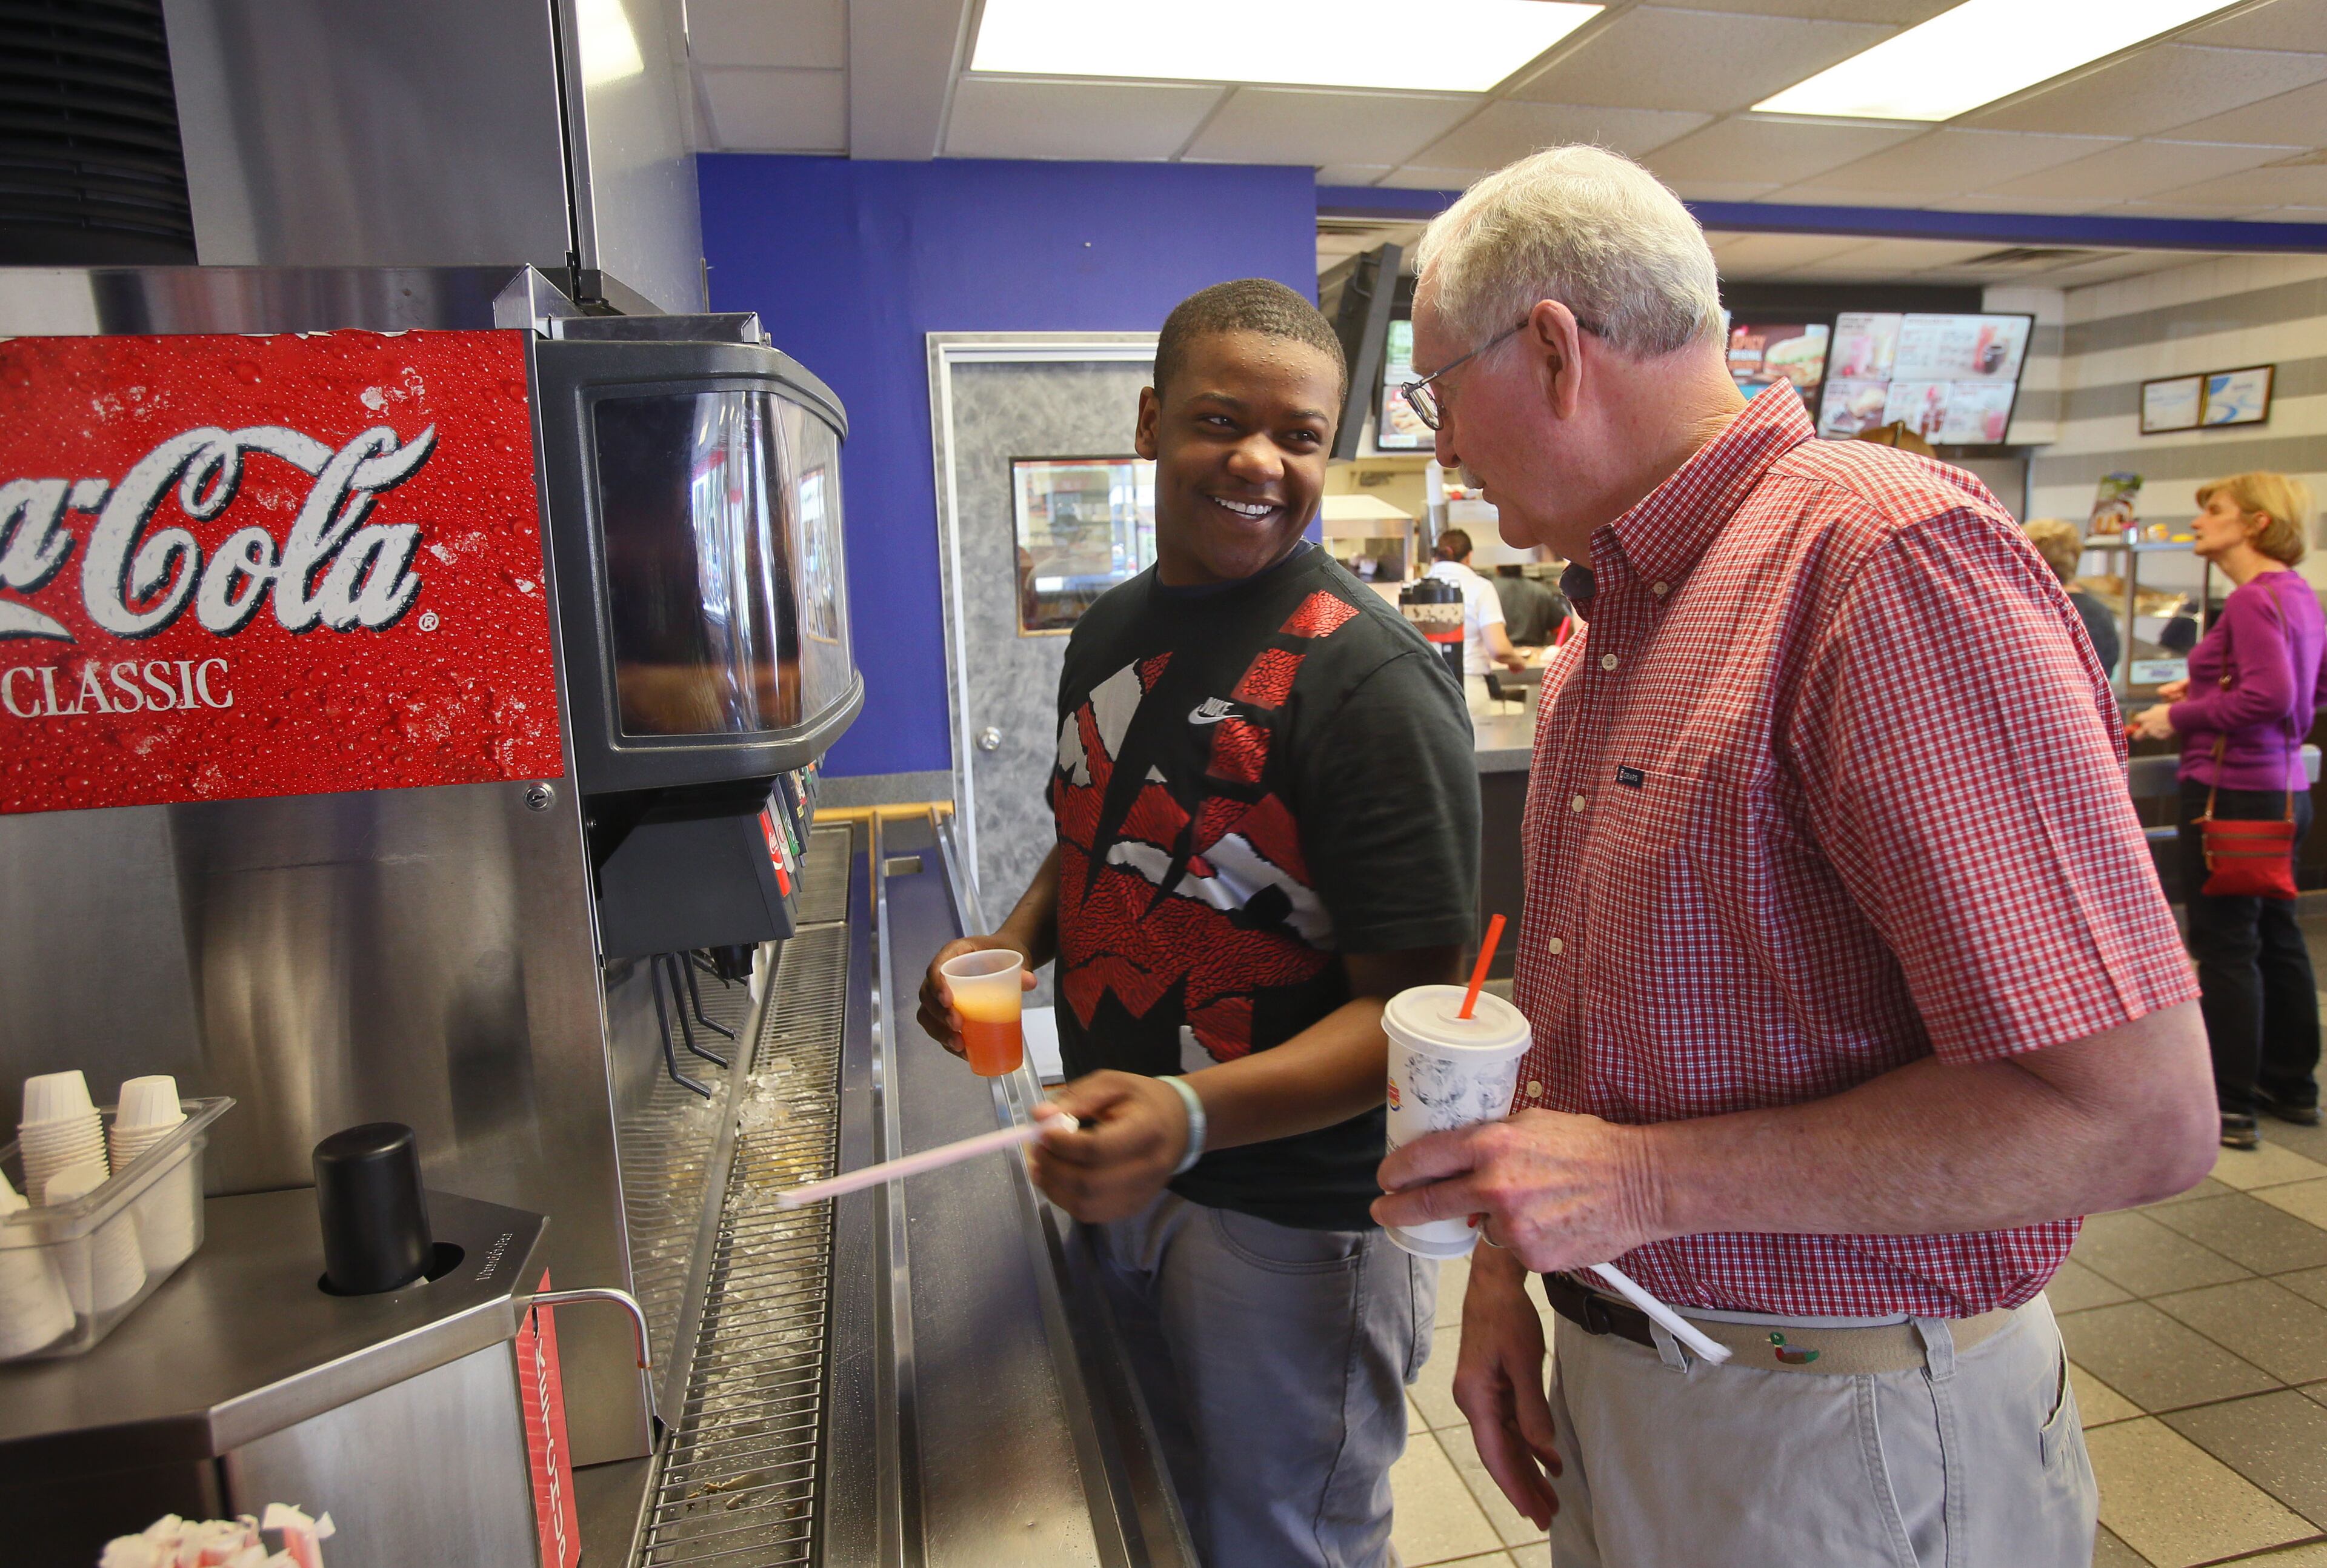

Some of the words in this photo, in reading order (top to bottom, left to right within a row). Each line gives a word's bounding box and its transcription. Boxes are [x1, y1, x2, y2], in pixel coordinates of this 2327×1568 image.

[2, 659, 234, 719] CLASSIC
[1199, 697, 1234, 717] NIKE
[1623, 772, 1639, 782] CHAPS
[535, 1337, 567, 1568] KETCHUP
